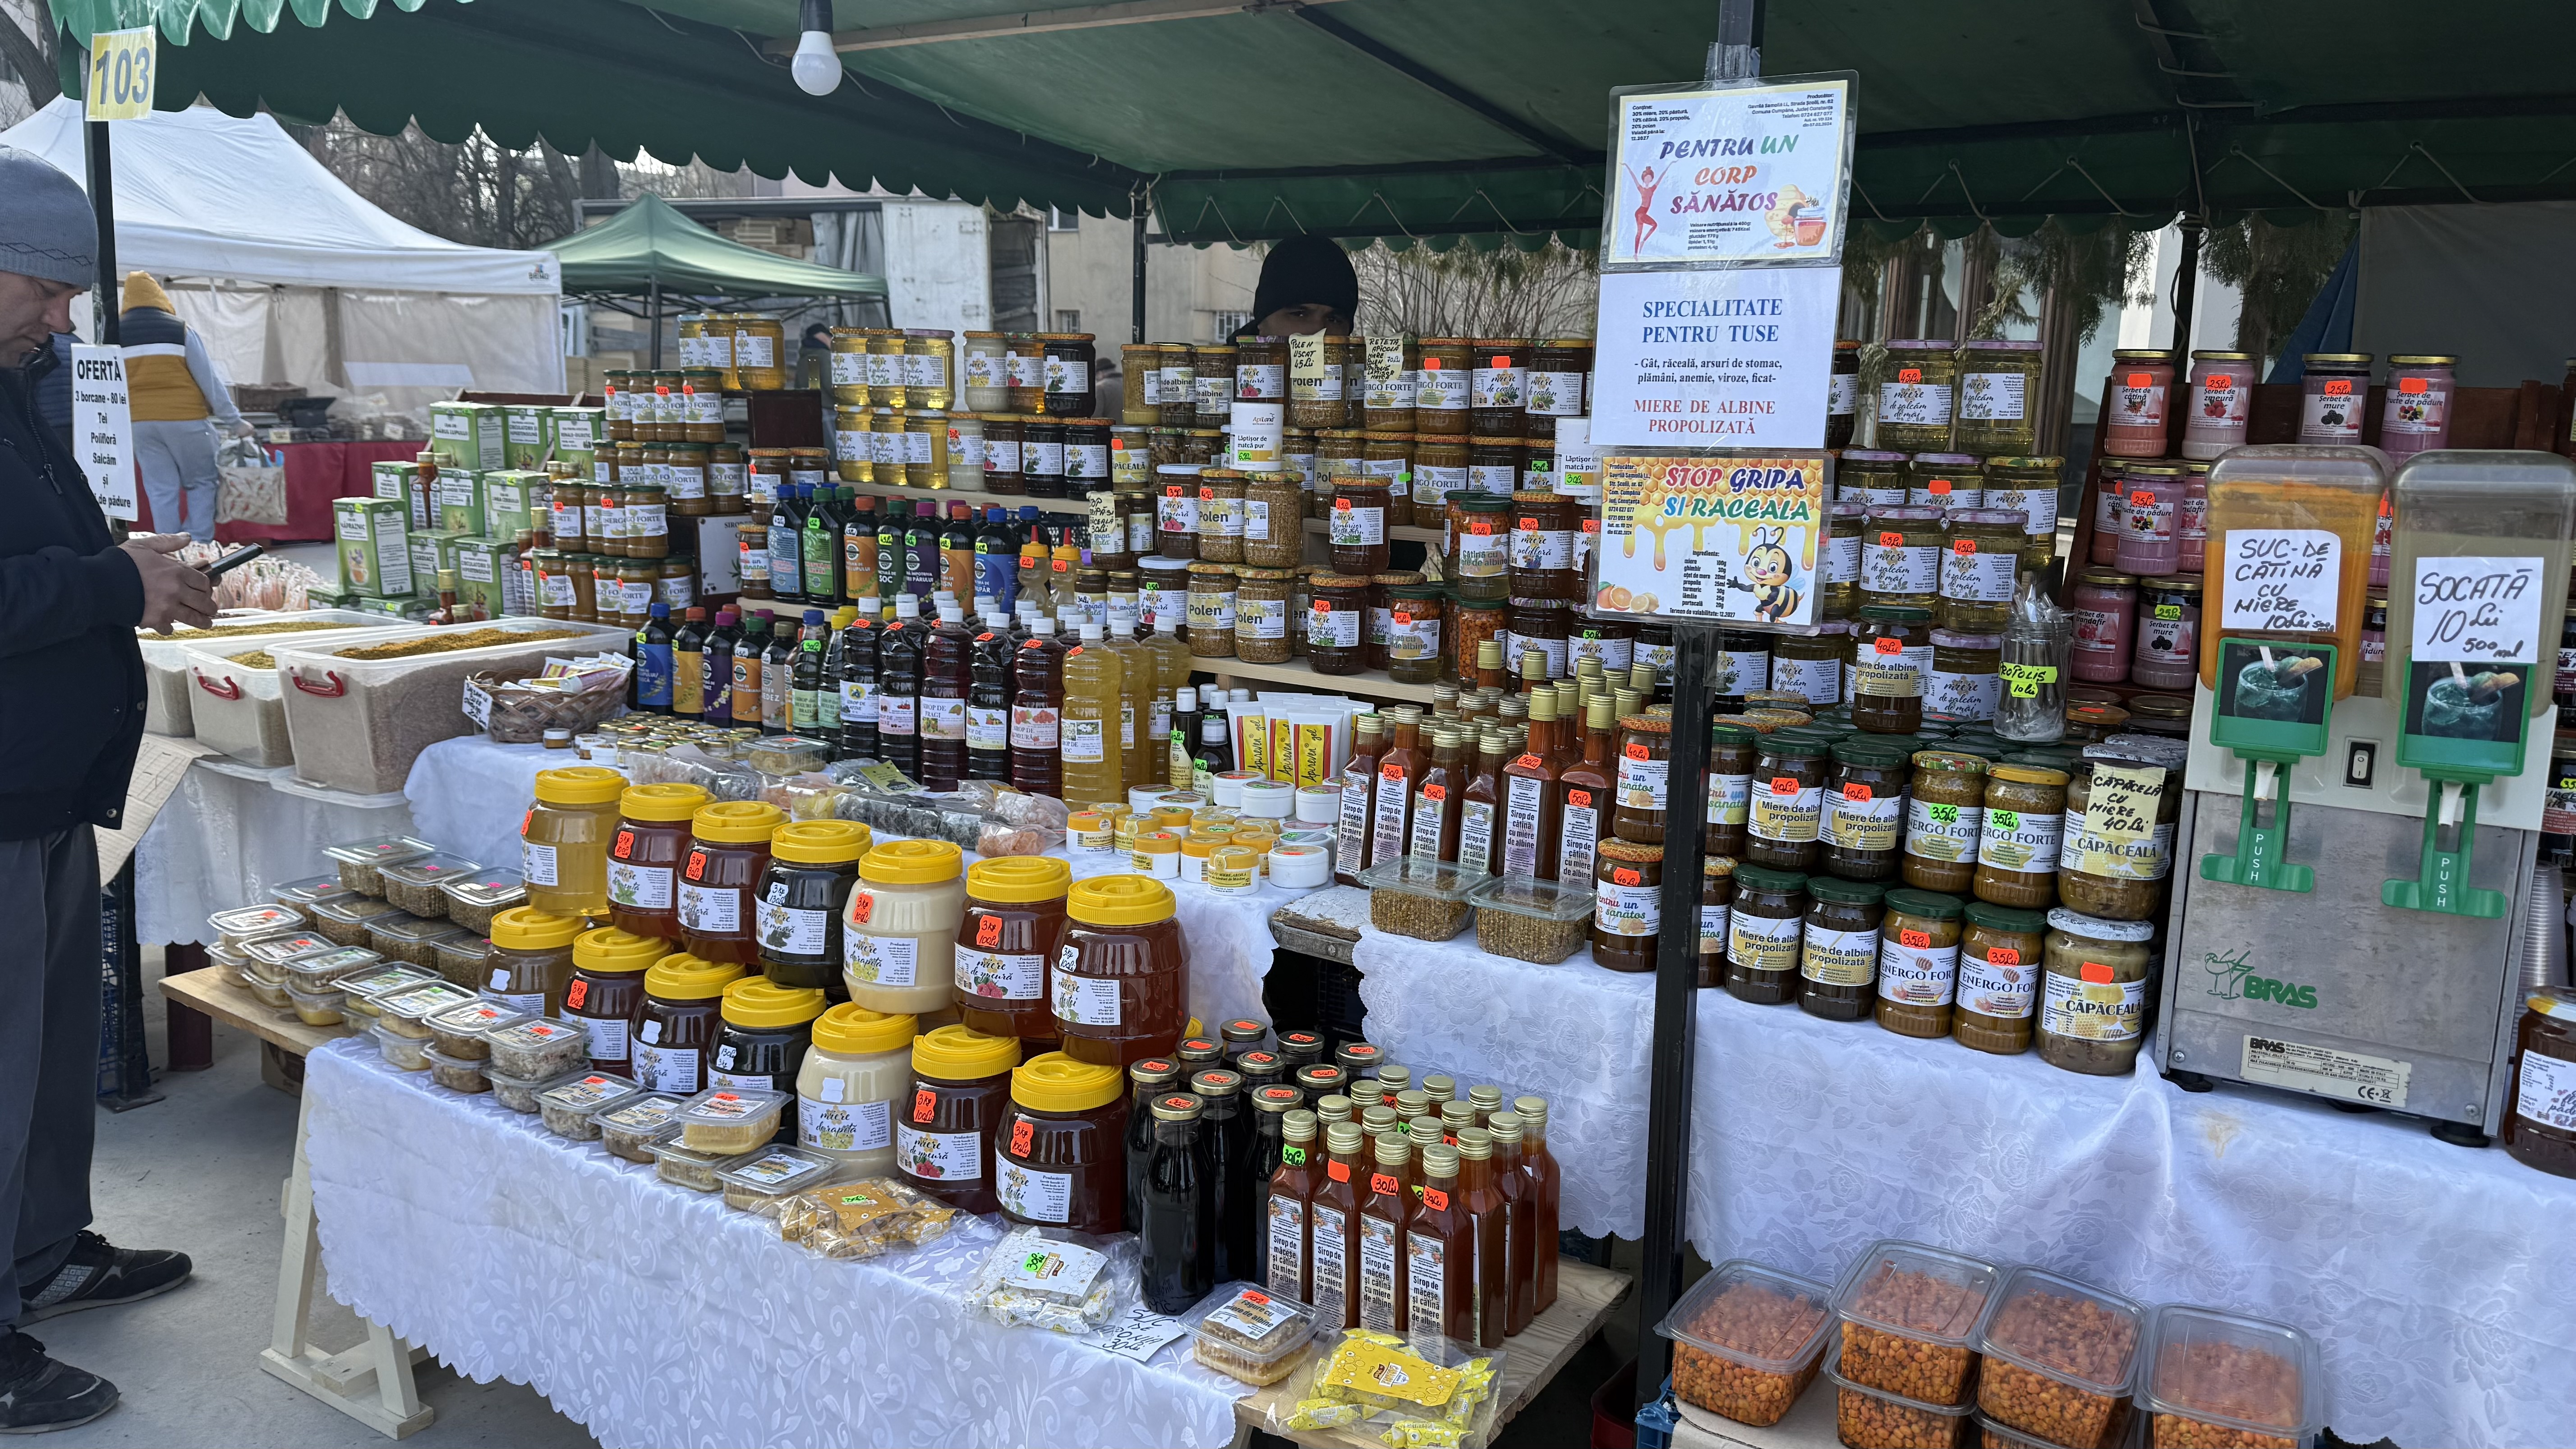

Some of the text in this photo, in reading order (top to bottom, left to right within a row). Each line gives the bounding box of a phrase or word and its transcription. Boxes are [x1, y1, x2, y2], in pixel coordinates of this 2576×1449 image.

[96, 47, 151, 105] 103
[1660, 135, 1799, 159] PENTRU UN
[1694, 166, 1757, 185] CORP
[1670, 189, 1778, 214] SĂNĂTOS
[1643, 299, 1782, 317] SPECIALITATE
[1642, 326, 1779, 343] PENTRU TUSE
[77, 356, 122, 381] OFERTĂ
[1641, 357, 1782, 369] Gât, răceală, arsuri de stomac,
[1638, 373, 1677, 384] plămâni,
[1680, 374, 1714, 383] anemie,
[1718, 374, 1748, 384] viroze,
[76, 391, 79, 401] 3
[81, 391, 106, 403] borcane
[110, 393, 118, 404] 80
[2416, 398, 2443, 407] pădure
[1634, 400, 1775, 414] MIERE DE ALBINE
[98, 413, 107, 423] Tei
[1649, 418, 1755, 434] PROPOLIZATĂ
[91, 432, 116, 445] Polifloră
[93, 453, 116, 465] Salcâm
[103, 474, 108, 488] și
[1666, 467, 1805, 493] STOP GRIPA
[98, 496, 106, 505] de
[109, 495, 131, 508] pădure
[1664, 497, 1809, 520] SI RACEALA
[1200, 511, 1228, 522] Polen
[2258, 584, 2287, 598] CU
[1189, 604, 1222, 616] Polen
[2427, 611, 2466, 645] 10
[1874, 660, 1917, 671] de albine
[1859, 669, 1909, 680] propolizată
[1250, 719, 1265, 731] gel
[1306, 729, 1322, 741] gel
[2107, 793, 2129, 804] CU
[1344, 804, 1356, 812] Sirop
[1343, 813, 1362, 822] măceșe
[1511, 810, 1526, 820] Sirop
[1513, 820, 1531, 829] cătină
[2103, 816, 2128, 831] 40
[1347, 835, 1362, 843] albine
[1517, 831, 1534, 839] miere
[2016, 833, 2055, 845] FORTE
[1516, 839, 1534, 848] albine
[2250, 833, 2264, 881] PUSH
[2437, 857, 2450, 908] PUSH
[1739, 929, 1780, 943] Miere de
[1745, 941, 1797, 952] propolizată
[1806, 940, 1872, 957] Miere de albine
[1810, 952, 1865, 966] propolizată
[1882, 962, 1926, 980] ENERGO
[1963, 972, 2013, 993] ENERGO
[2243, 975, 2318, 1009] BRAS
[2250, 1038, 2285, 1053] BRAS
[1274, 1236, 1289, 1247] Sirop
[1274, 1247, 1296, 1259] măceșe
[1279, 1256, 1297, 1268] cătină
[1280, 1266, 1297, 1276] miere
[1280, 1274, 1297, 1285] albine
[1242, 1300, 1260, 1312] Fagure
[1128, 1309, 1176, 1326] SUC
[1251, 1315, 1274, 1328] albine
